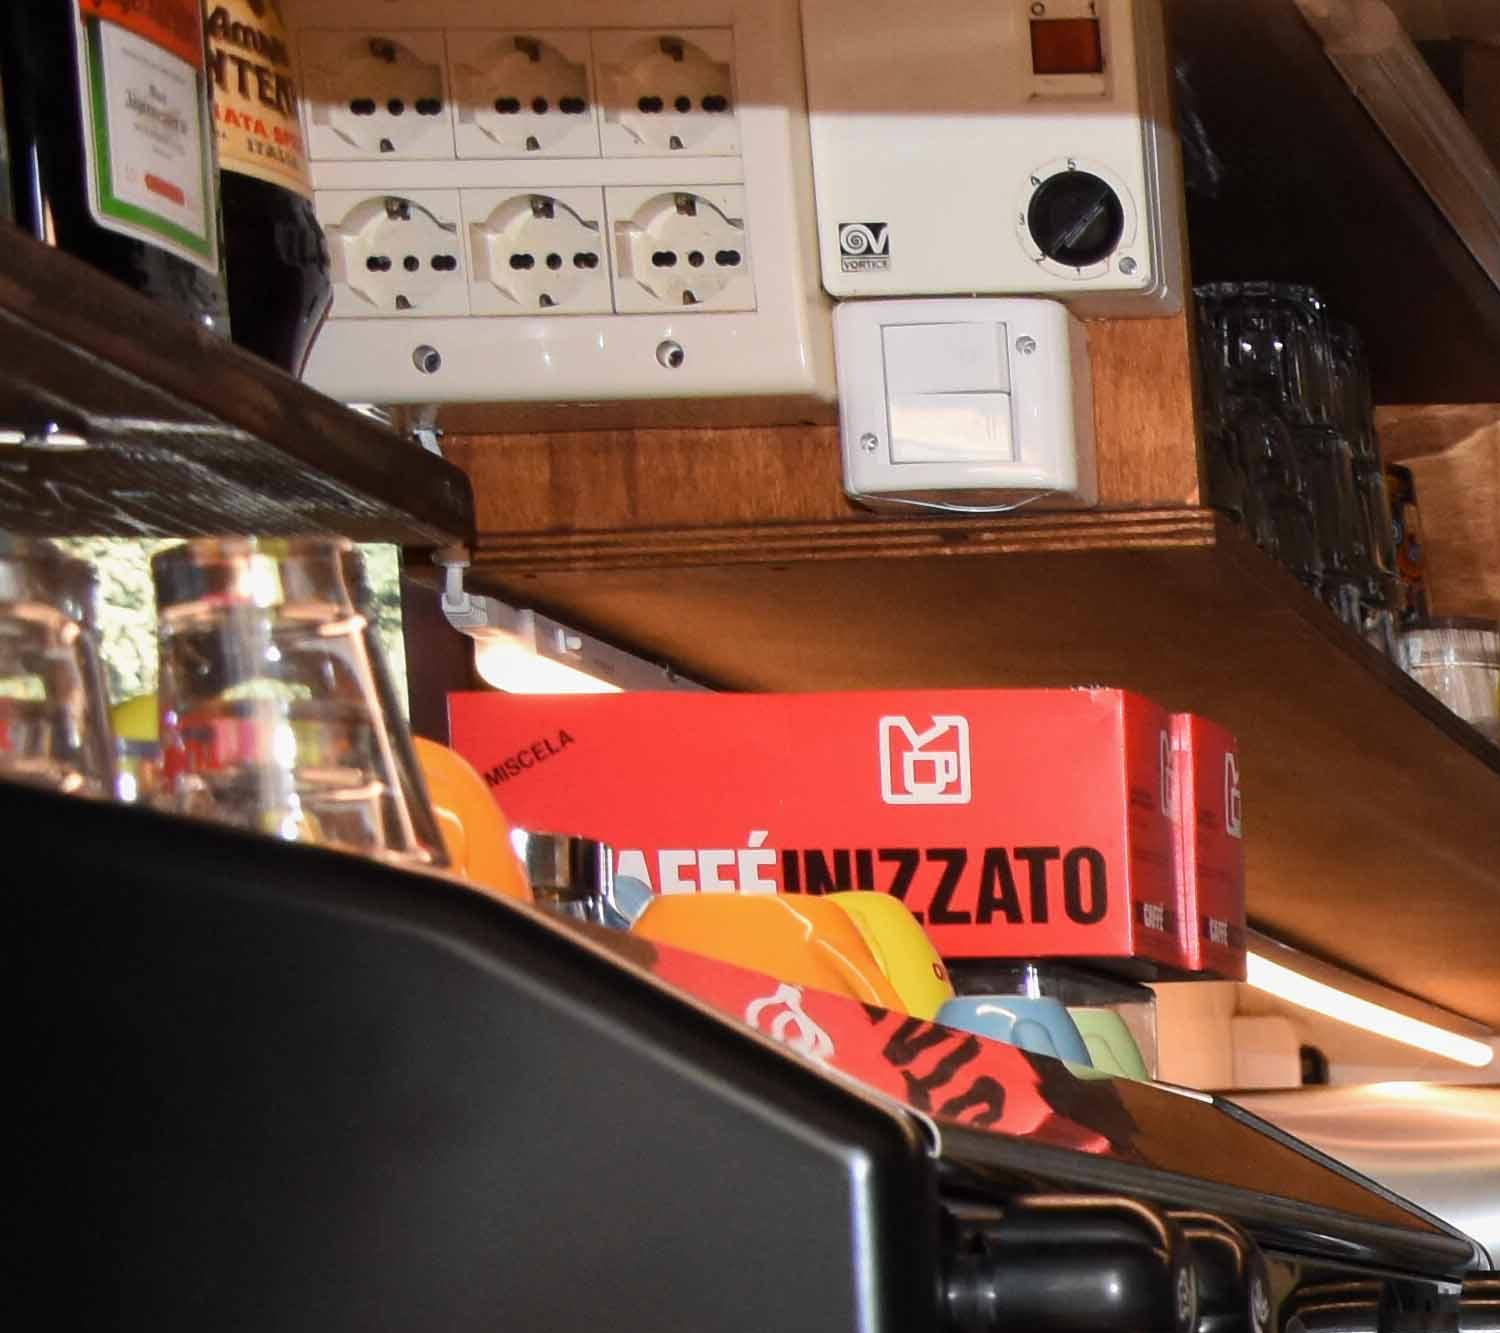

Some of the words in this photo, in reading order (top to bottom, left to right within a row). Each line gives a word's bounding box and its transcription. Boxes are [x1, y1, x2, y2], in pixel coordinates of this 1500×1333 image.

[842, 258, 889, 271] VORTICE
[485, 726, 577, 789] MISCELA
[613, 830, 1108, 926] AFFÉINIZZATO
